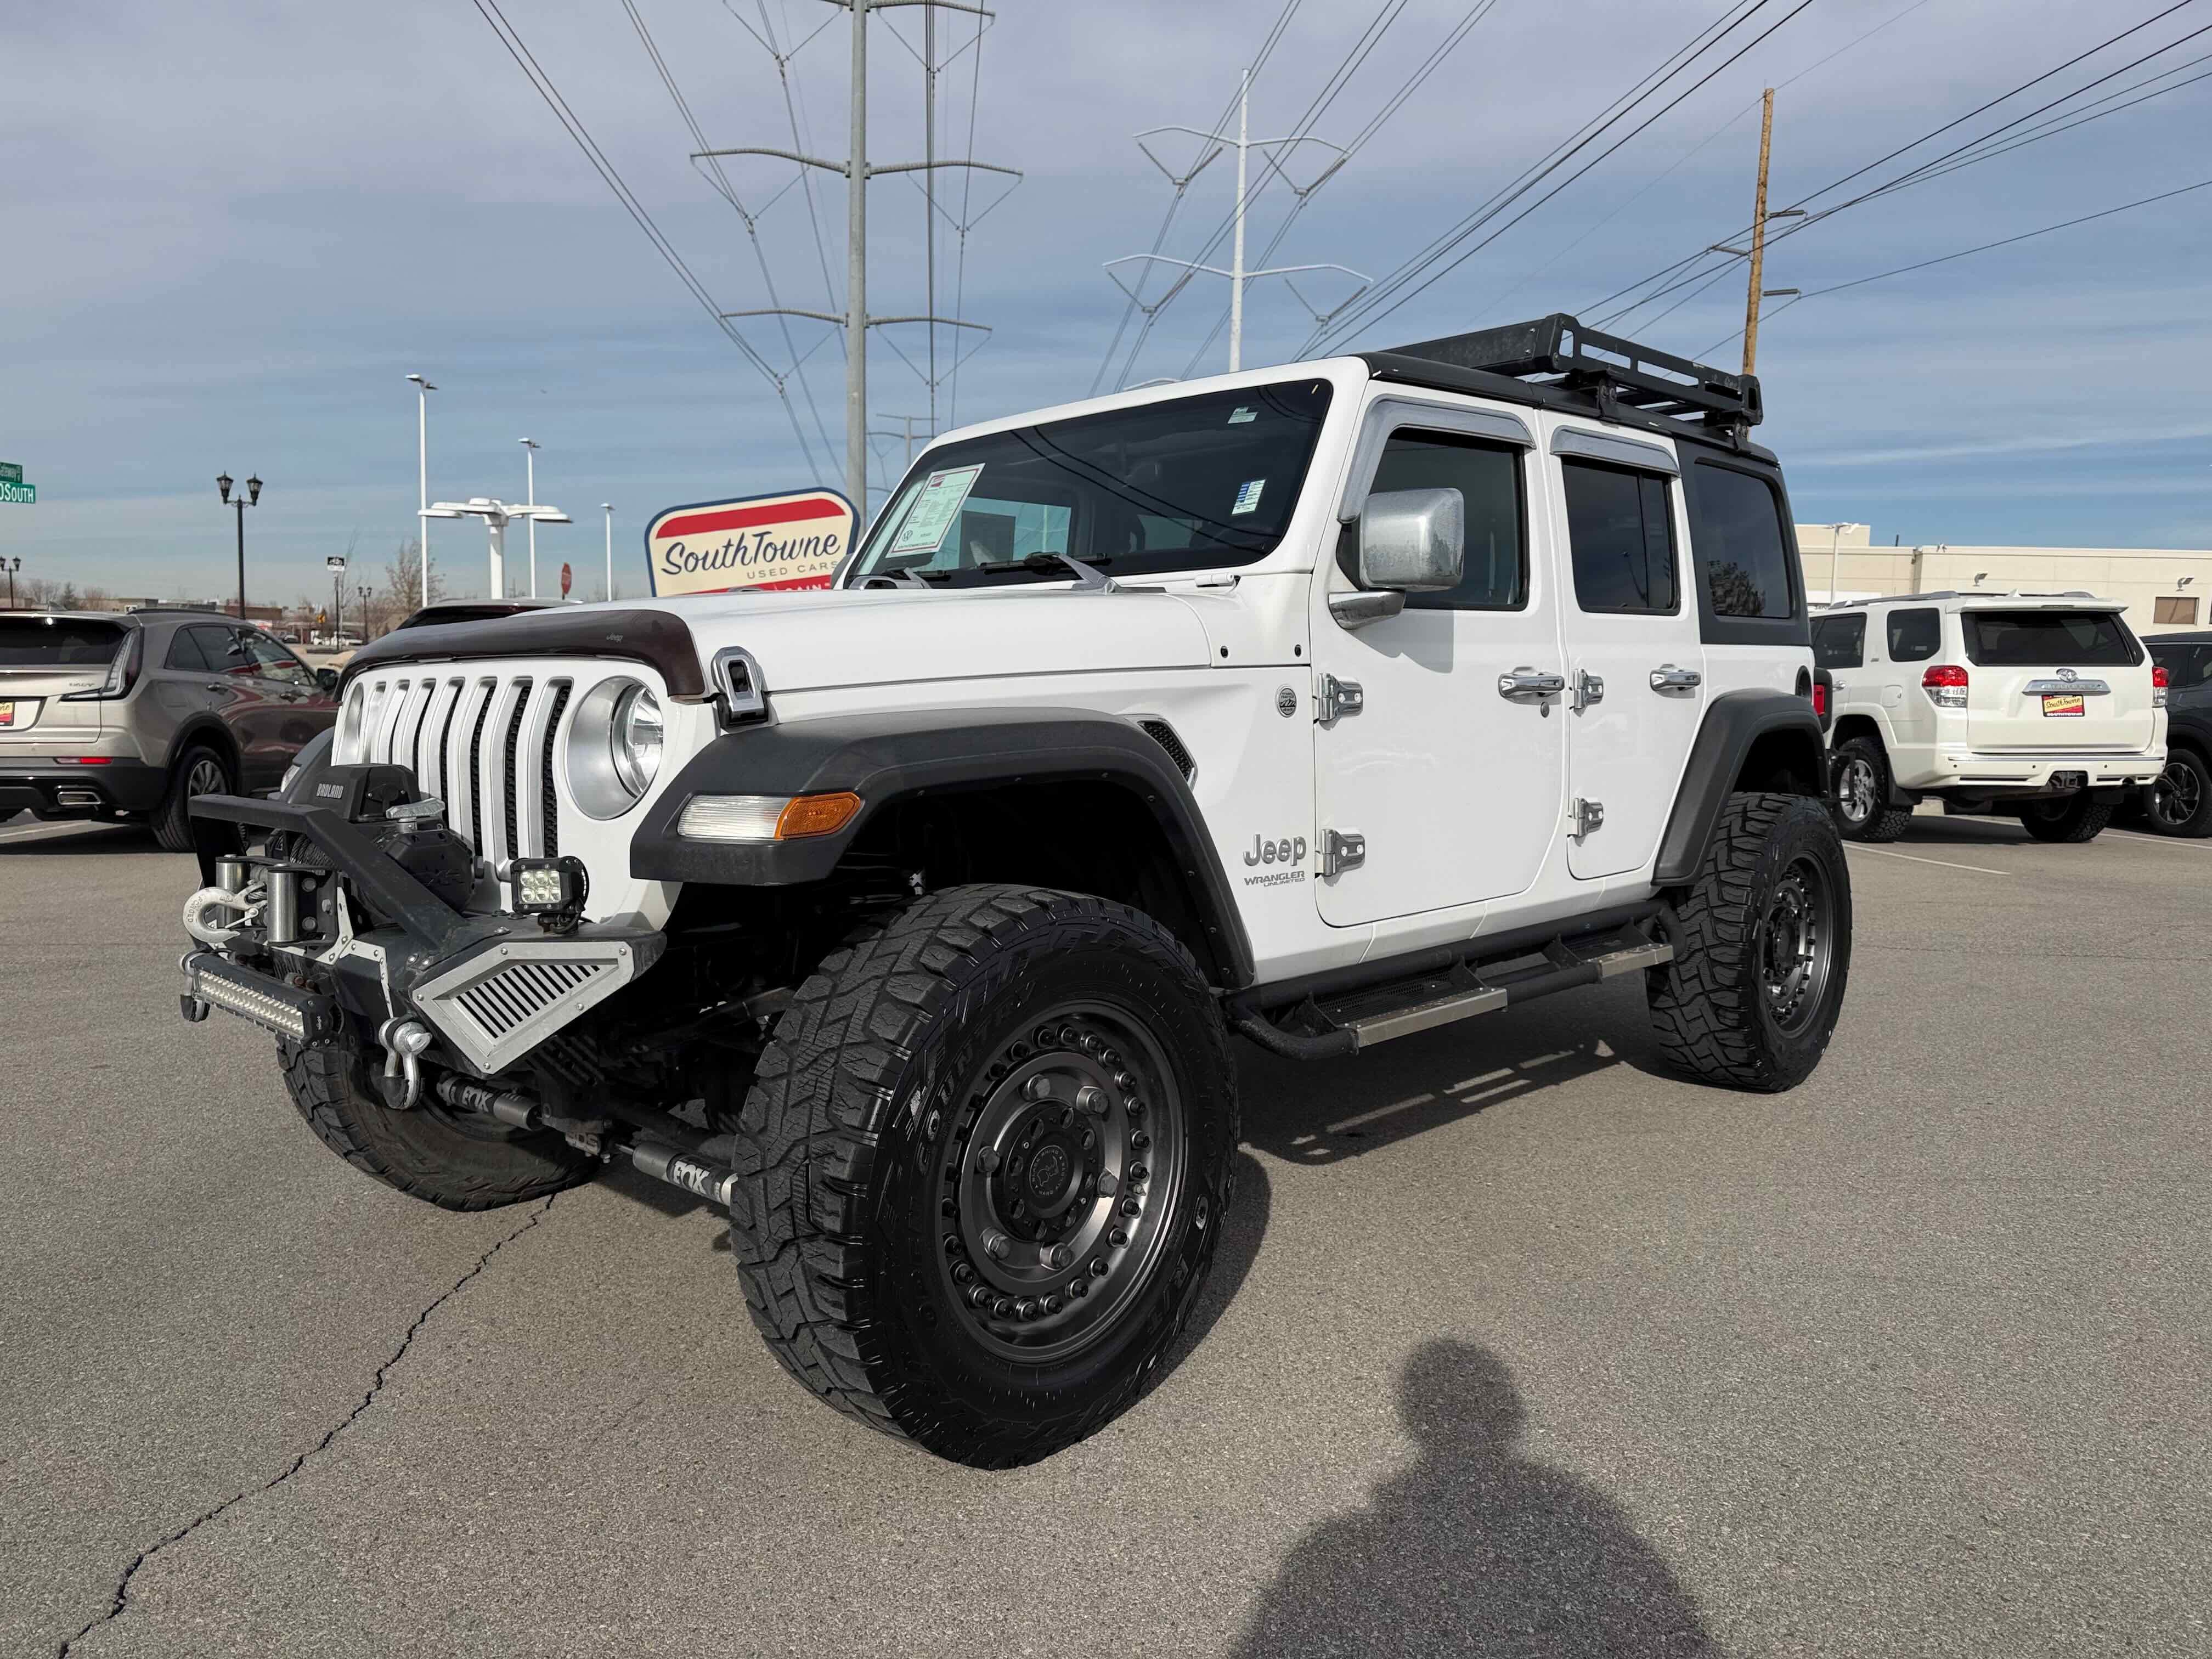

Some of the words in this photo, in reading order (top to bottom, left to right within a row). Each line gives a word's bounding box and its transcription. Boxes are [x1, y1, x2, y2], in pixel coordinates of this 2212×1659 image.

[661, 531, 841, 575] SouthTowne
[747, 567, 788, 579] USED
[797, 561, 836, 573] CARS
[2046, 697, 2081, 709] SouthTowne
[317, 783, 344, 799] BADLAND
[1243, 833, 1306, 867] Jeep
[1244, 871, 1305, 886] WRANGLER
[1263, 878, 1305, 887] UNLIMITED
[461, 1085, 494, 1113] FOX
[673, 1160, 710, 1195] FOX
